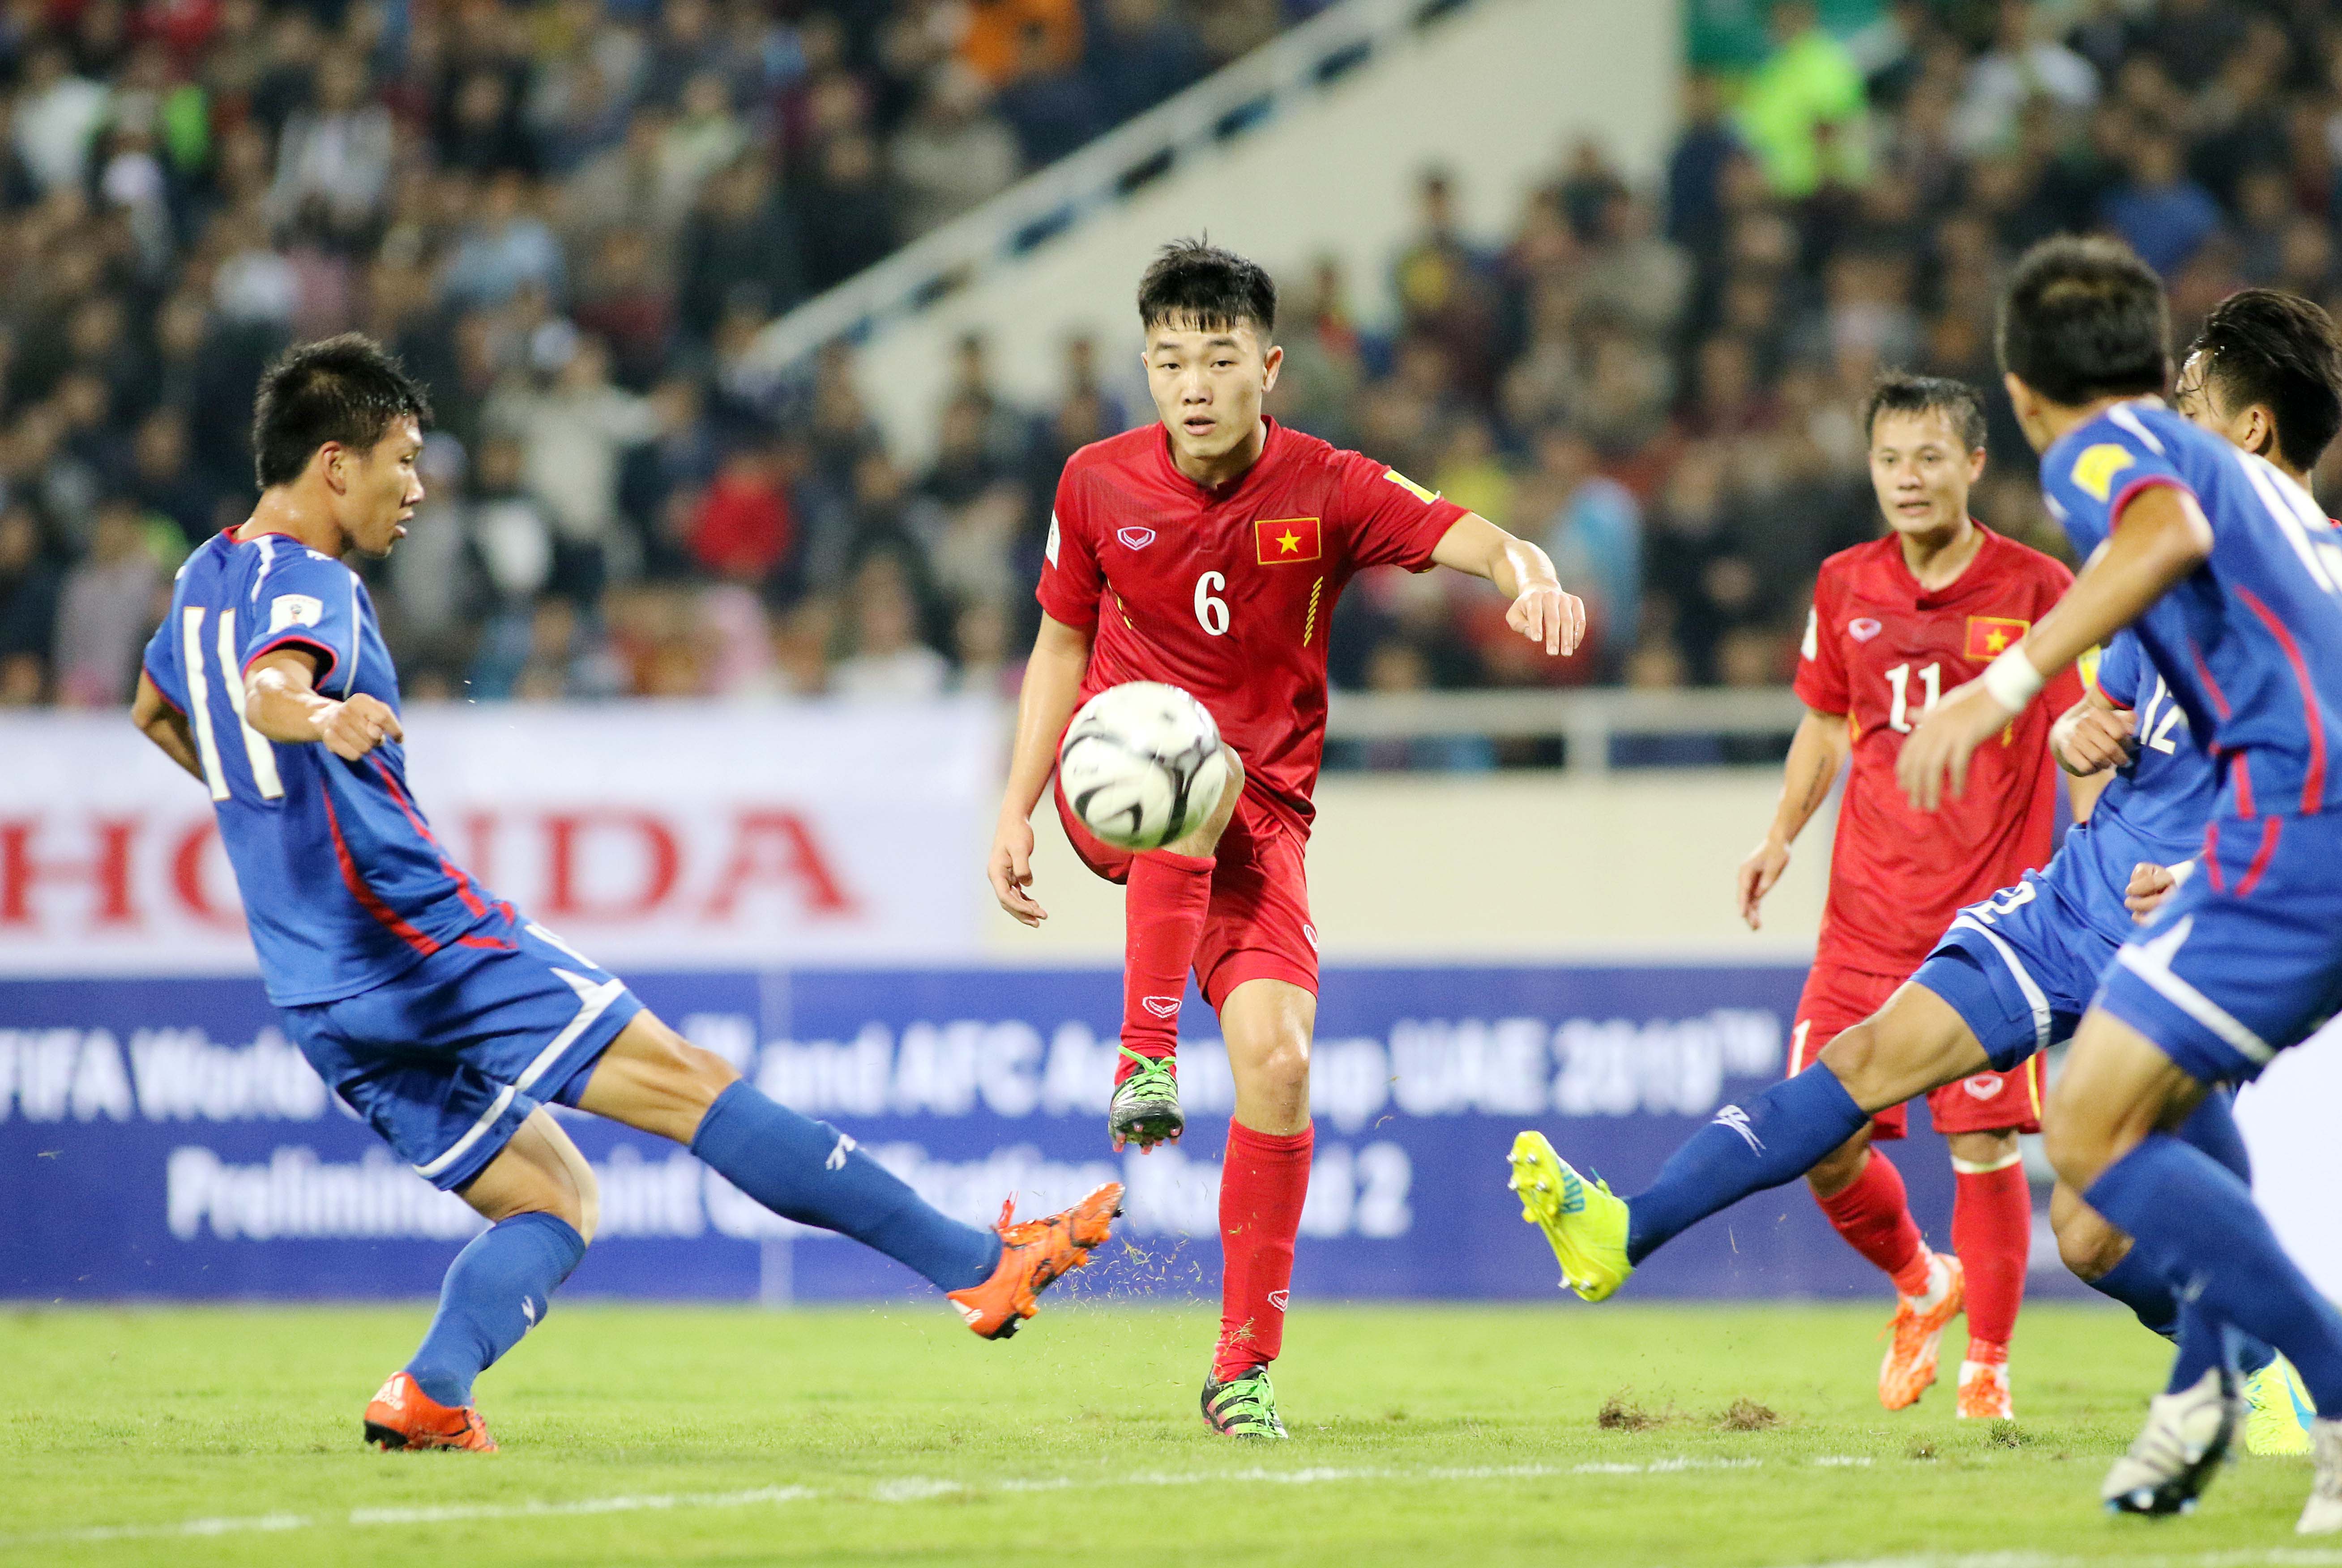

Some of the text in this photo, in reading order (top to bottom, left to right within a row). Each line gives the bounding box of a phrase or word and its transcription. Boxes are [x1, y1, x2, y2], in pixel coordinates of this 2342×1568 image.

[1194, 571, 1230, 636] 6
[183, 606, 285, 801] 11
[1884, 662, 1941, 734] 11
[2140, 673, 2190, 755] 12
[895, 1020, 1042, 1116] AFC
[1390, 1018, 1547, 1116] UAE
[167, 1146, 495, 1240] Prelimin
[1358, 1141, 1411, 1239] 2
